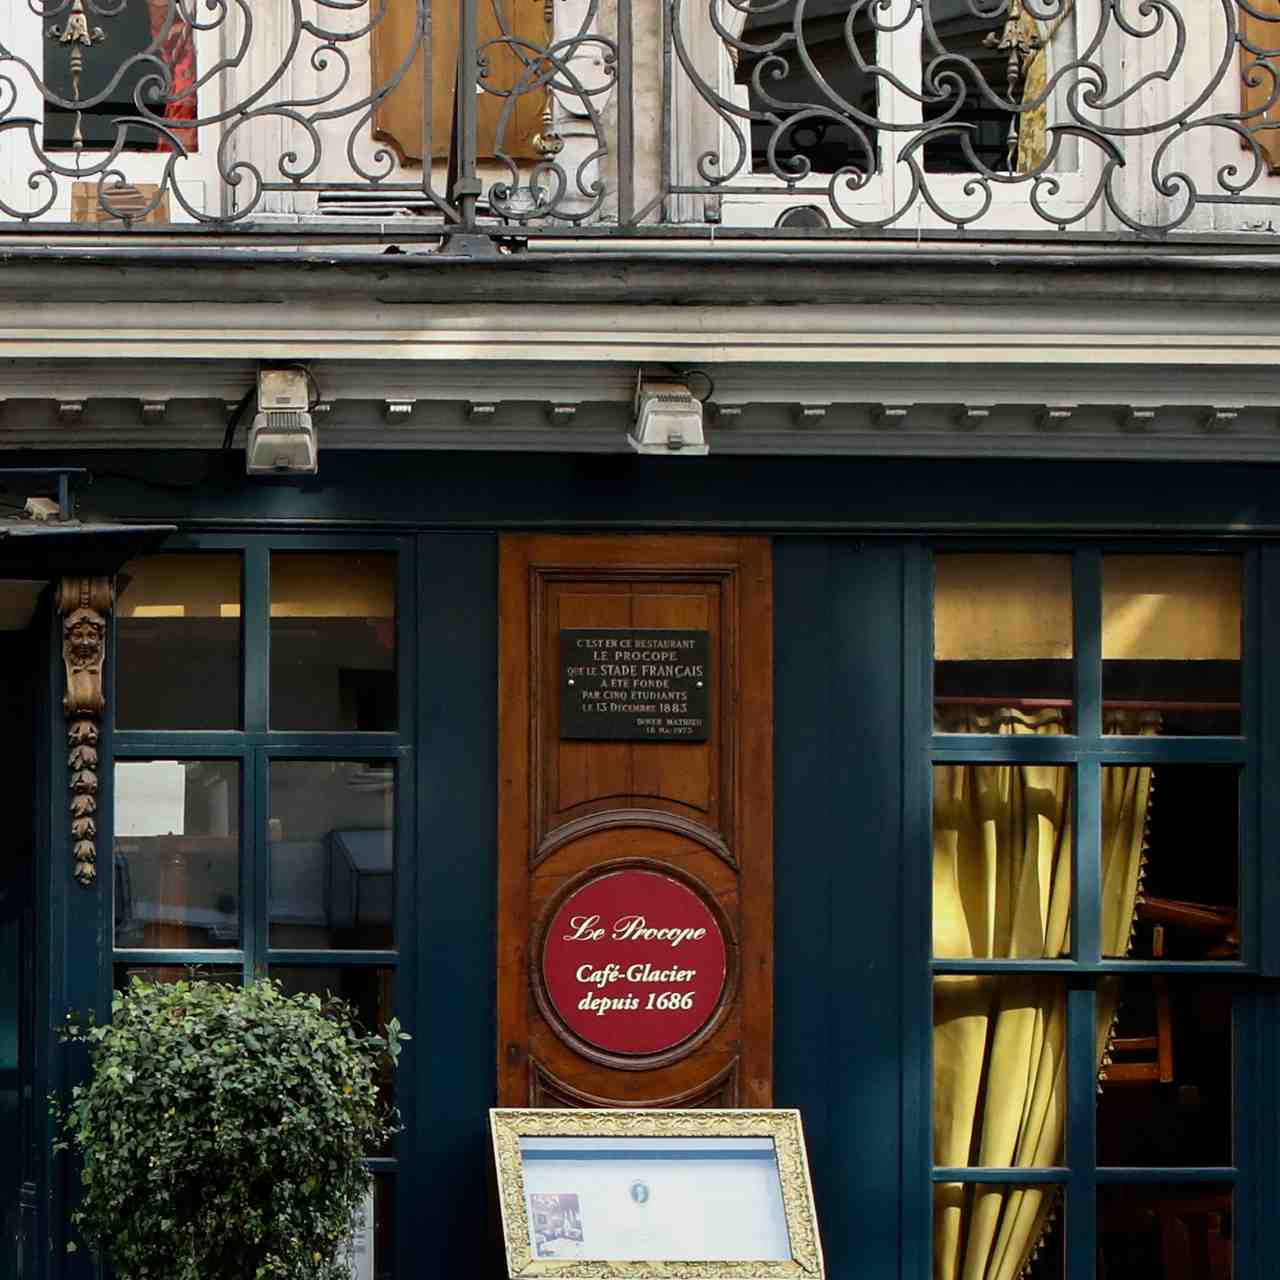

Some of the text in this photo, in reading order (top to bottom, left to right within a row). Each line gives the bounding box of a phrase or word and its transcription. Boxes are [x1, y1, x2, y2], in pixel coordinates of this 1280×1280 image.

[634, 639, 697, 650] RESTAURANT
[593, 651, 679, 662] LE PROCOPE
[586, 667, 599, 676] LE
[600, 664, 638, 677] STADE
[602, 690, 628, 701] CINQ
[659, 703, 688, 713] 1883
[563, 915, 707, 947] Le Procope
[575, 962, 697, 988] Café-Glacier
[577, 991, 696, 1016] depuis 1686
